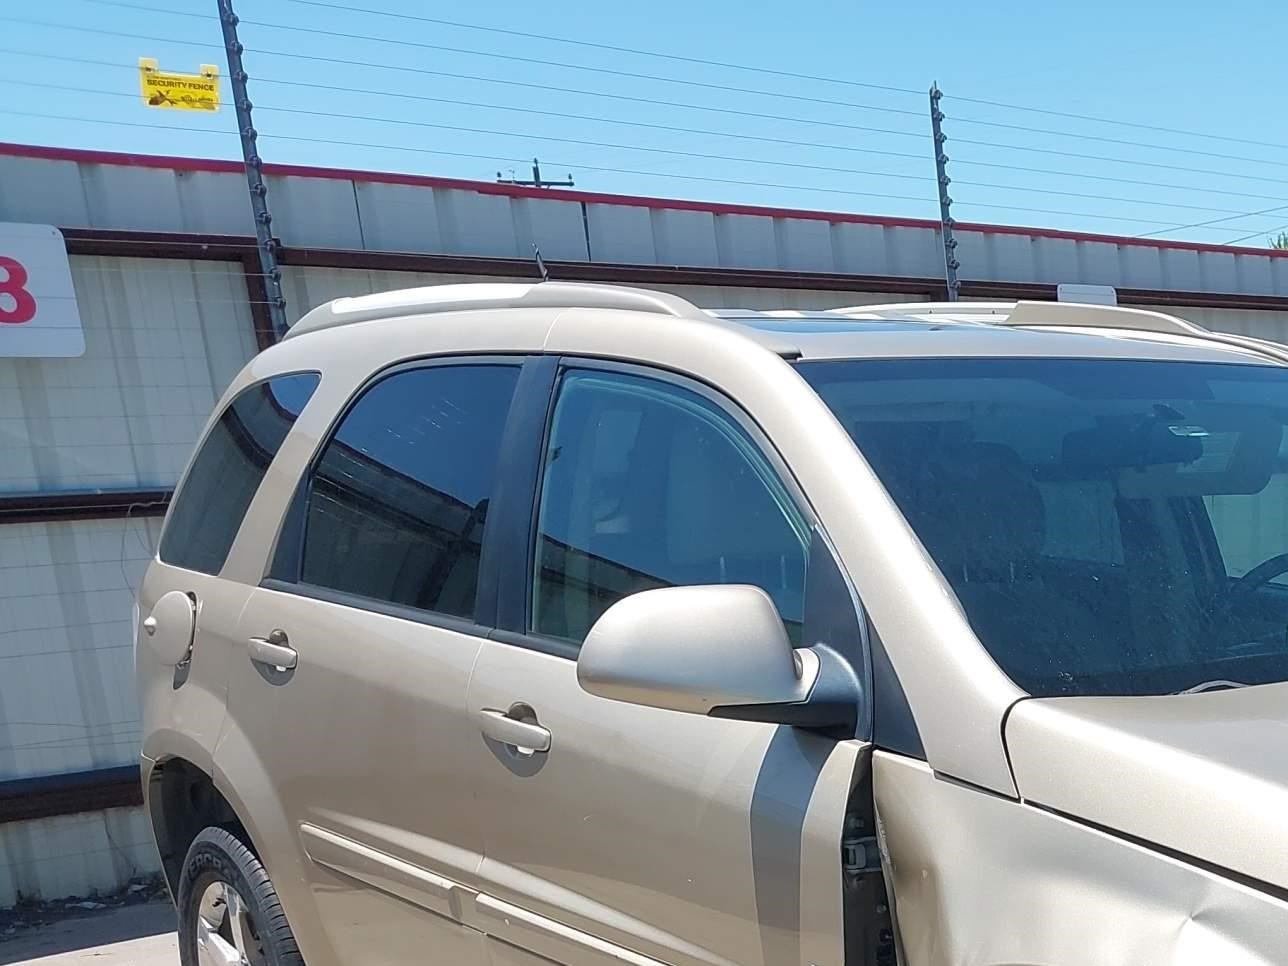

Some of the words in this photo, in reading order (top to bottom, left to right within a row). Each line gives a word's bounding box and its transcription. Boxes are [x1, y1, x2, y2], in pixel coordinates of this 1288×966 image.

[147, 79, 187, 89] SECURITY
[188, 82, 215, 92] FENCE
[0, 255, 37, 324] 8
